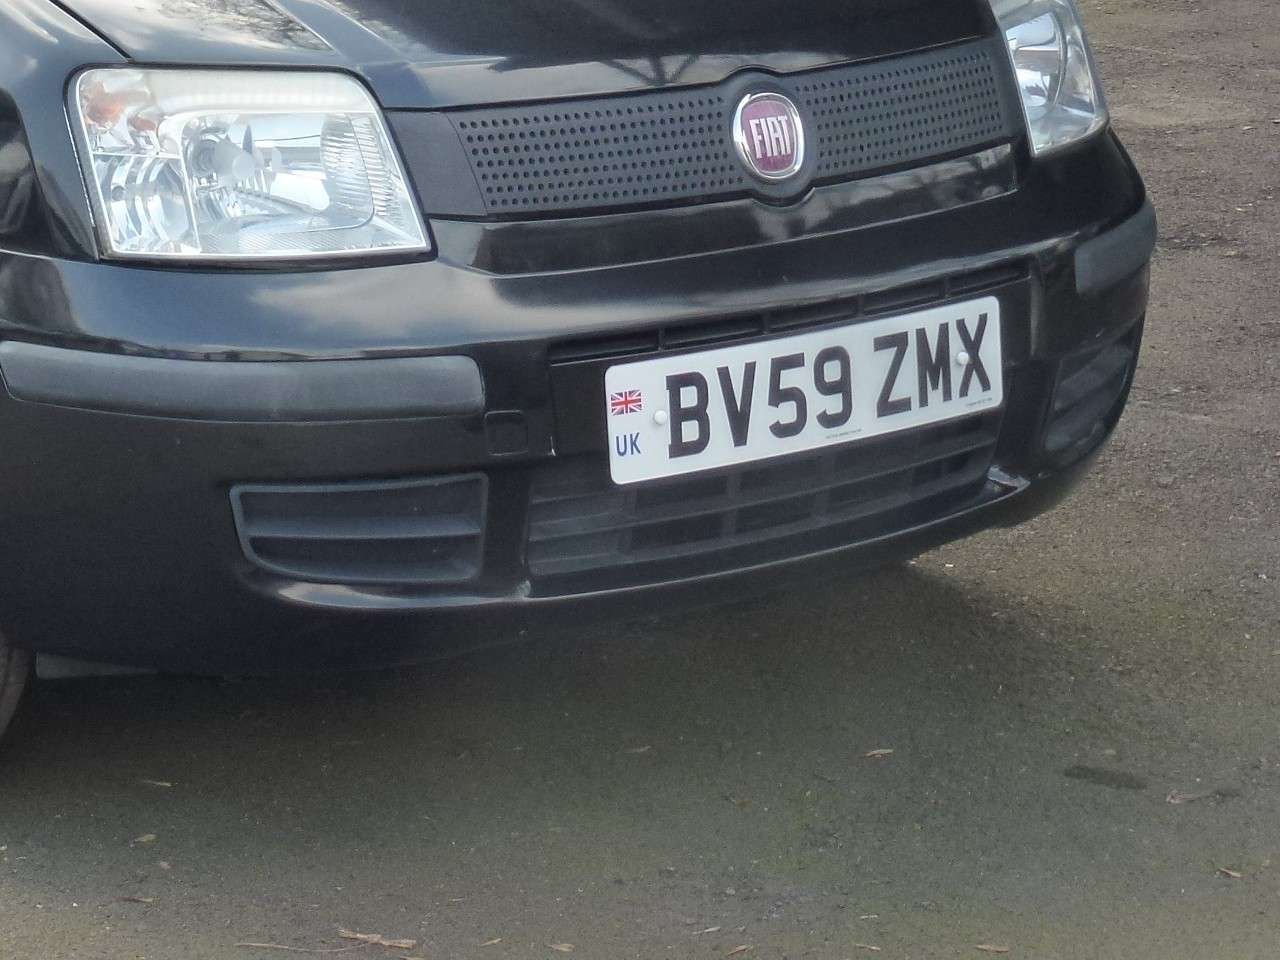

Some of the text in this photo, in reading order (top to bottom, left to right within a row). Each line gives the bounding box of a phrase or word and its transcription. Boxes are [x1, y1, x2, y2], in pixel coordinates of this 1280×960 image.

[749, 115, 791, 159] FIAT
[665, 313, 991, 459] BV59 ZMX
[616, 432, 641, 456] UK
